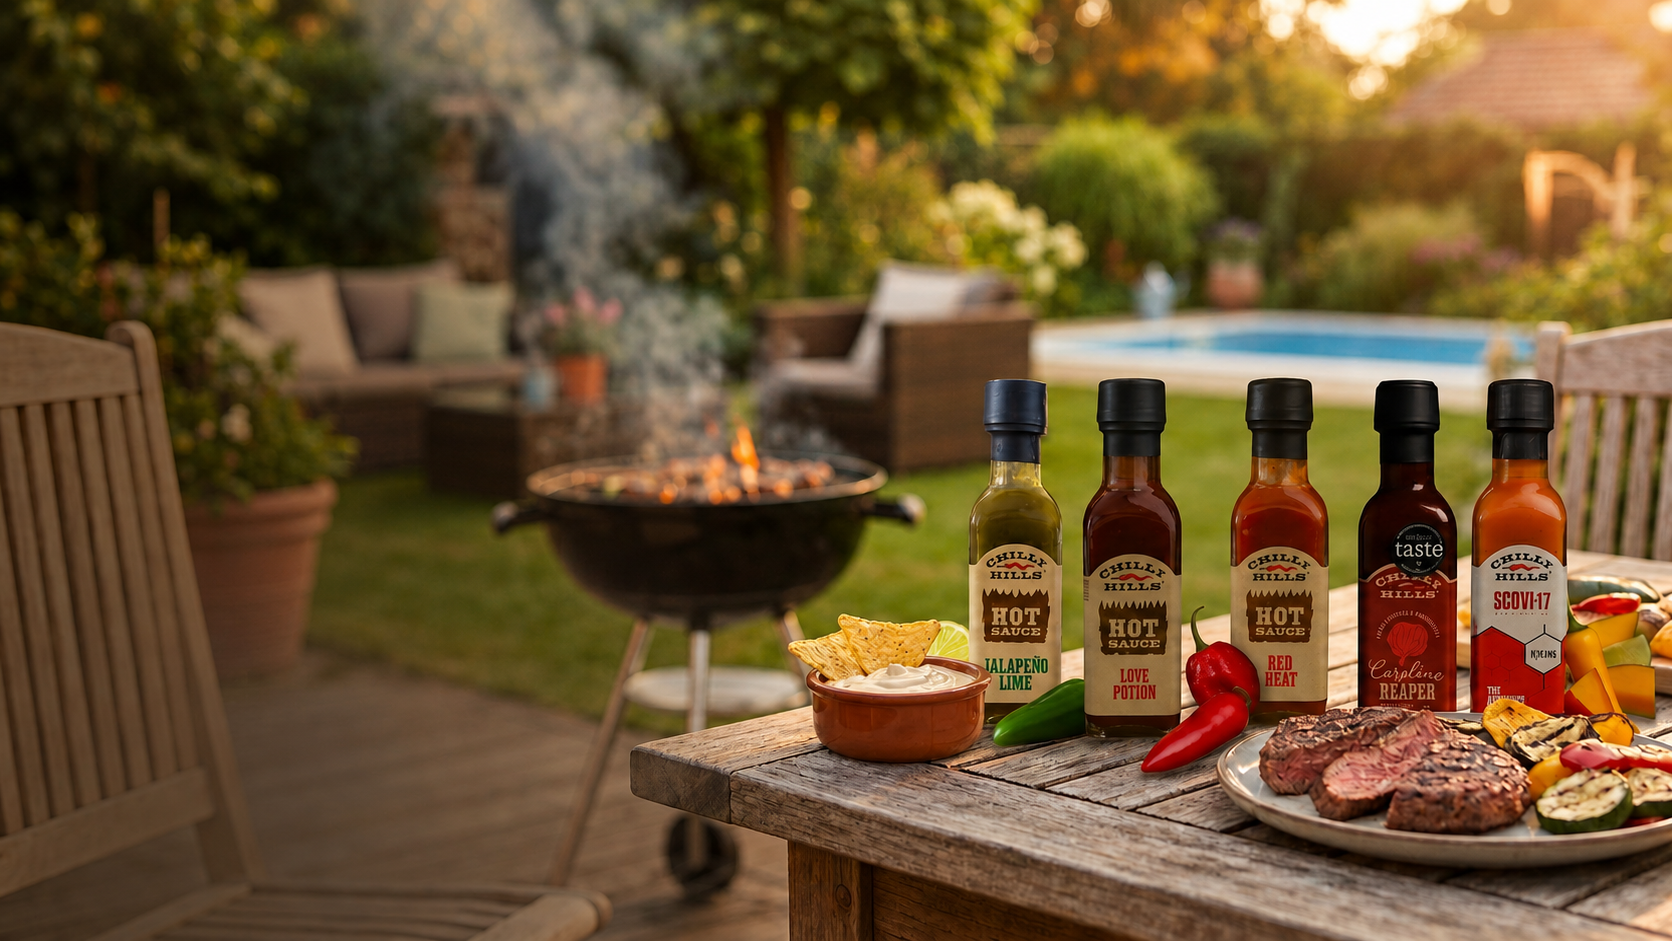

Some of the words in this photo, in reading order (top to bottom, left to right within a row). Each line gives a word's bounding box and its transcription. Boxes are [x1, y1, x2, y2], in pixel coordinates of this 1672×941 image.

[1395, 542, 1443, 557] taste
[986, 552, 1047, 568] CHILLY
[1248, 554, 1311, 570] CHILLY
[1491, 553, 1553, 569] CHILLY
[990, 571, 1042, 579] HILLS
[1099, 562, 1166, 579] CHILLY
[1495, 573, 1548, 581] HILLS
[1104, 583, 1161, 591] HILLS
[1380, 590, 1436, 598] HILLS
[992, 607, 1040, 625] HOT
[1256, 607, 1304, 625] HOT
[991, 628, 1040, 636] SAUCE
[1109, 619, 1158, 637] HOT
[1109, 640, 1160, 648] SAUCE
[985, 656, 1048, 673] JALAPEÑO
[1268, 655, 1292, 670] RED
[999, 675, 1032, 690] LIME
[1120, 668, 1149, 682] LOVE
[1265, 672, 1297, 687] HEAT
[1113, 685, 1156, 700] POTION
[1379, 683, 1435, 700] REAPER
